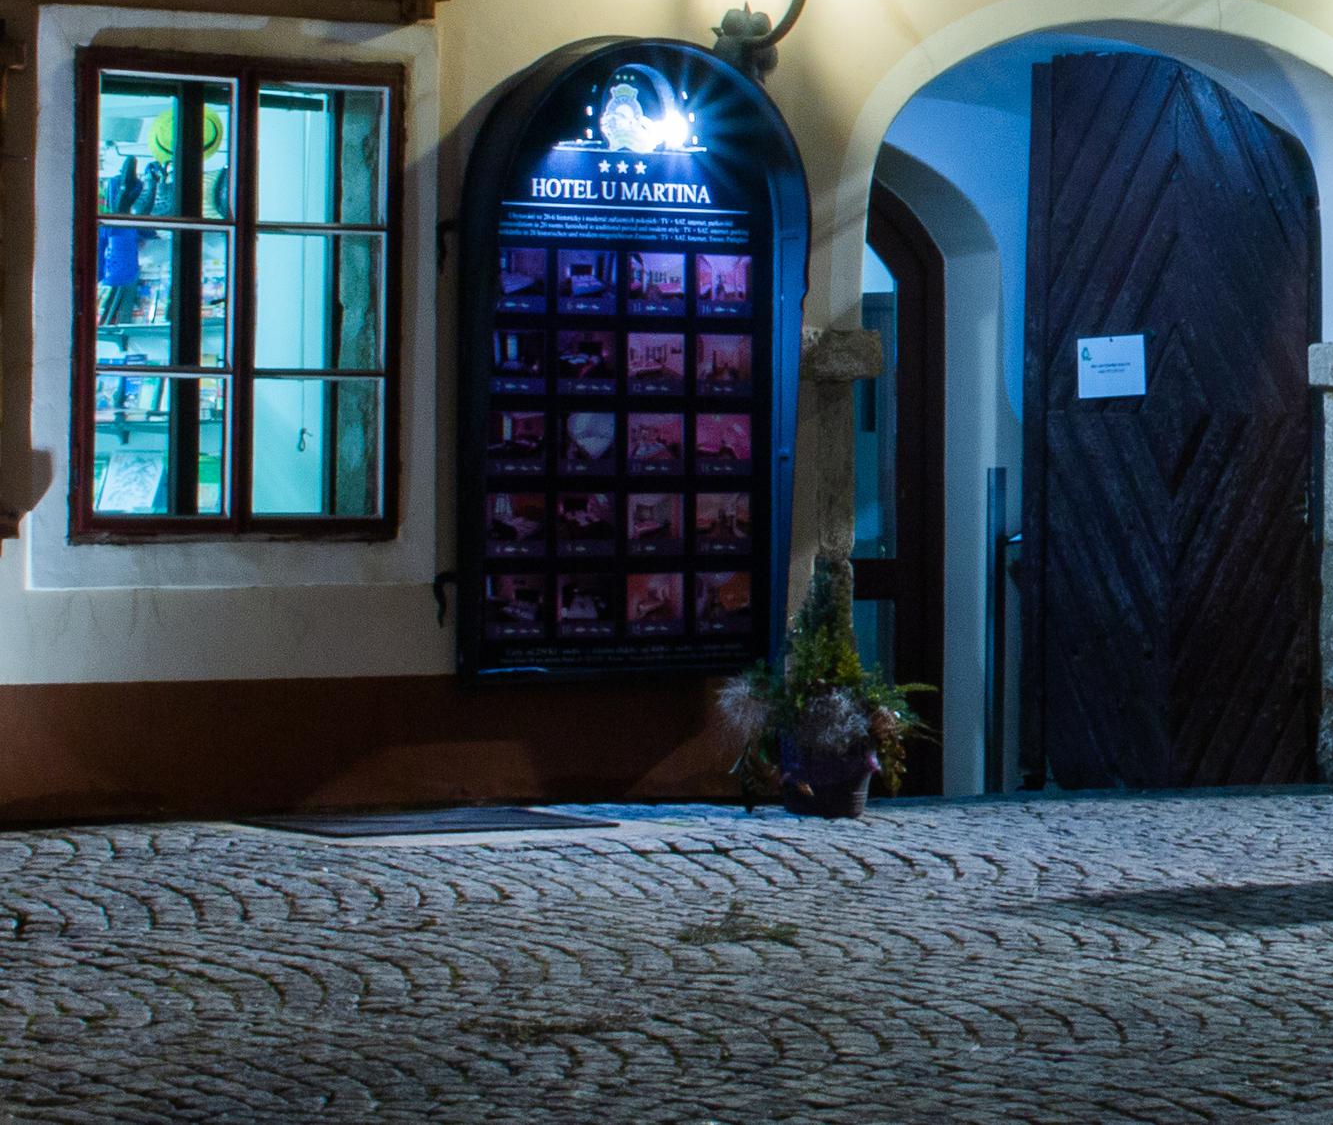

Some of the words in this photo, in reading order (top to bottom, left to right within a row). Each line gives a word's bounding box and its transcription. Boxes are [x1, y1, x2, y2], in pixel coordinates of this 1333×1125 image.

[530, 177, 598, 201] HOTEL
[602, 180, 617, 200] U
[620, 182, 711, 204] MARTINA
